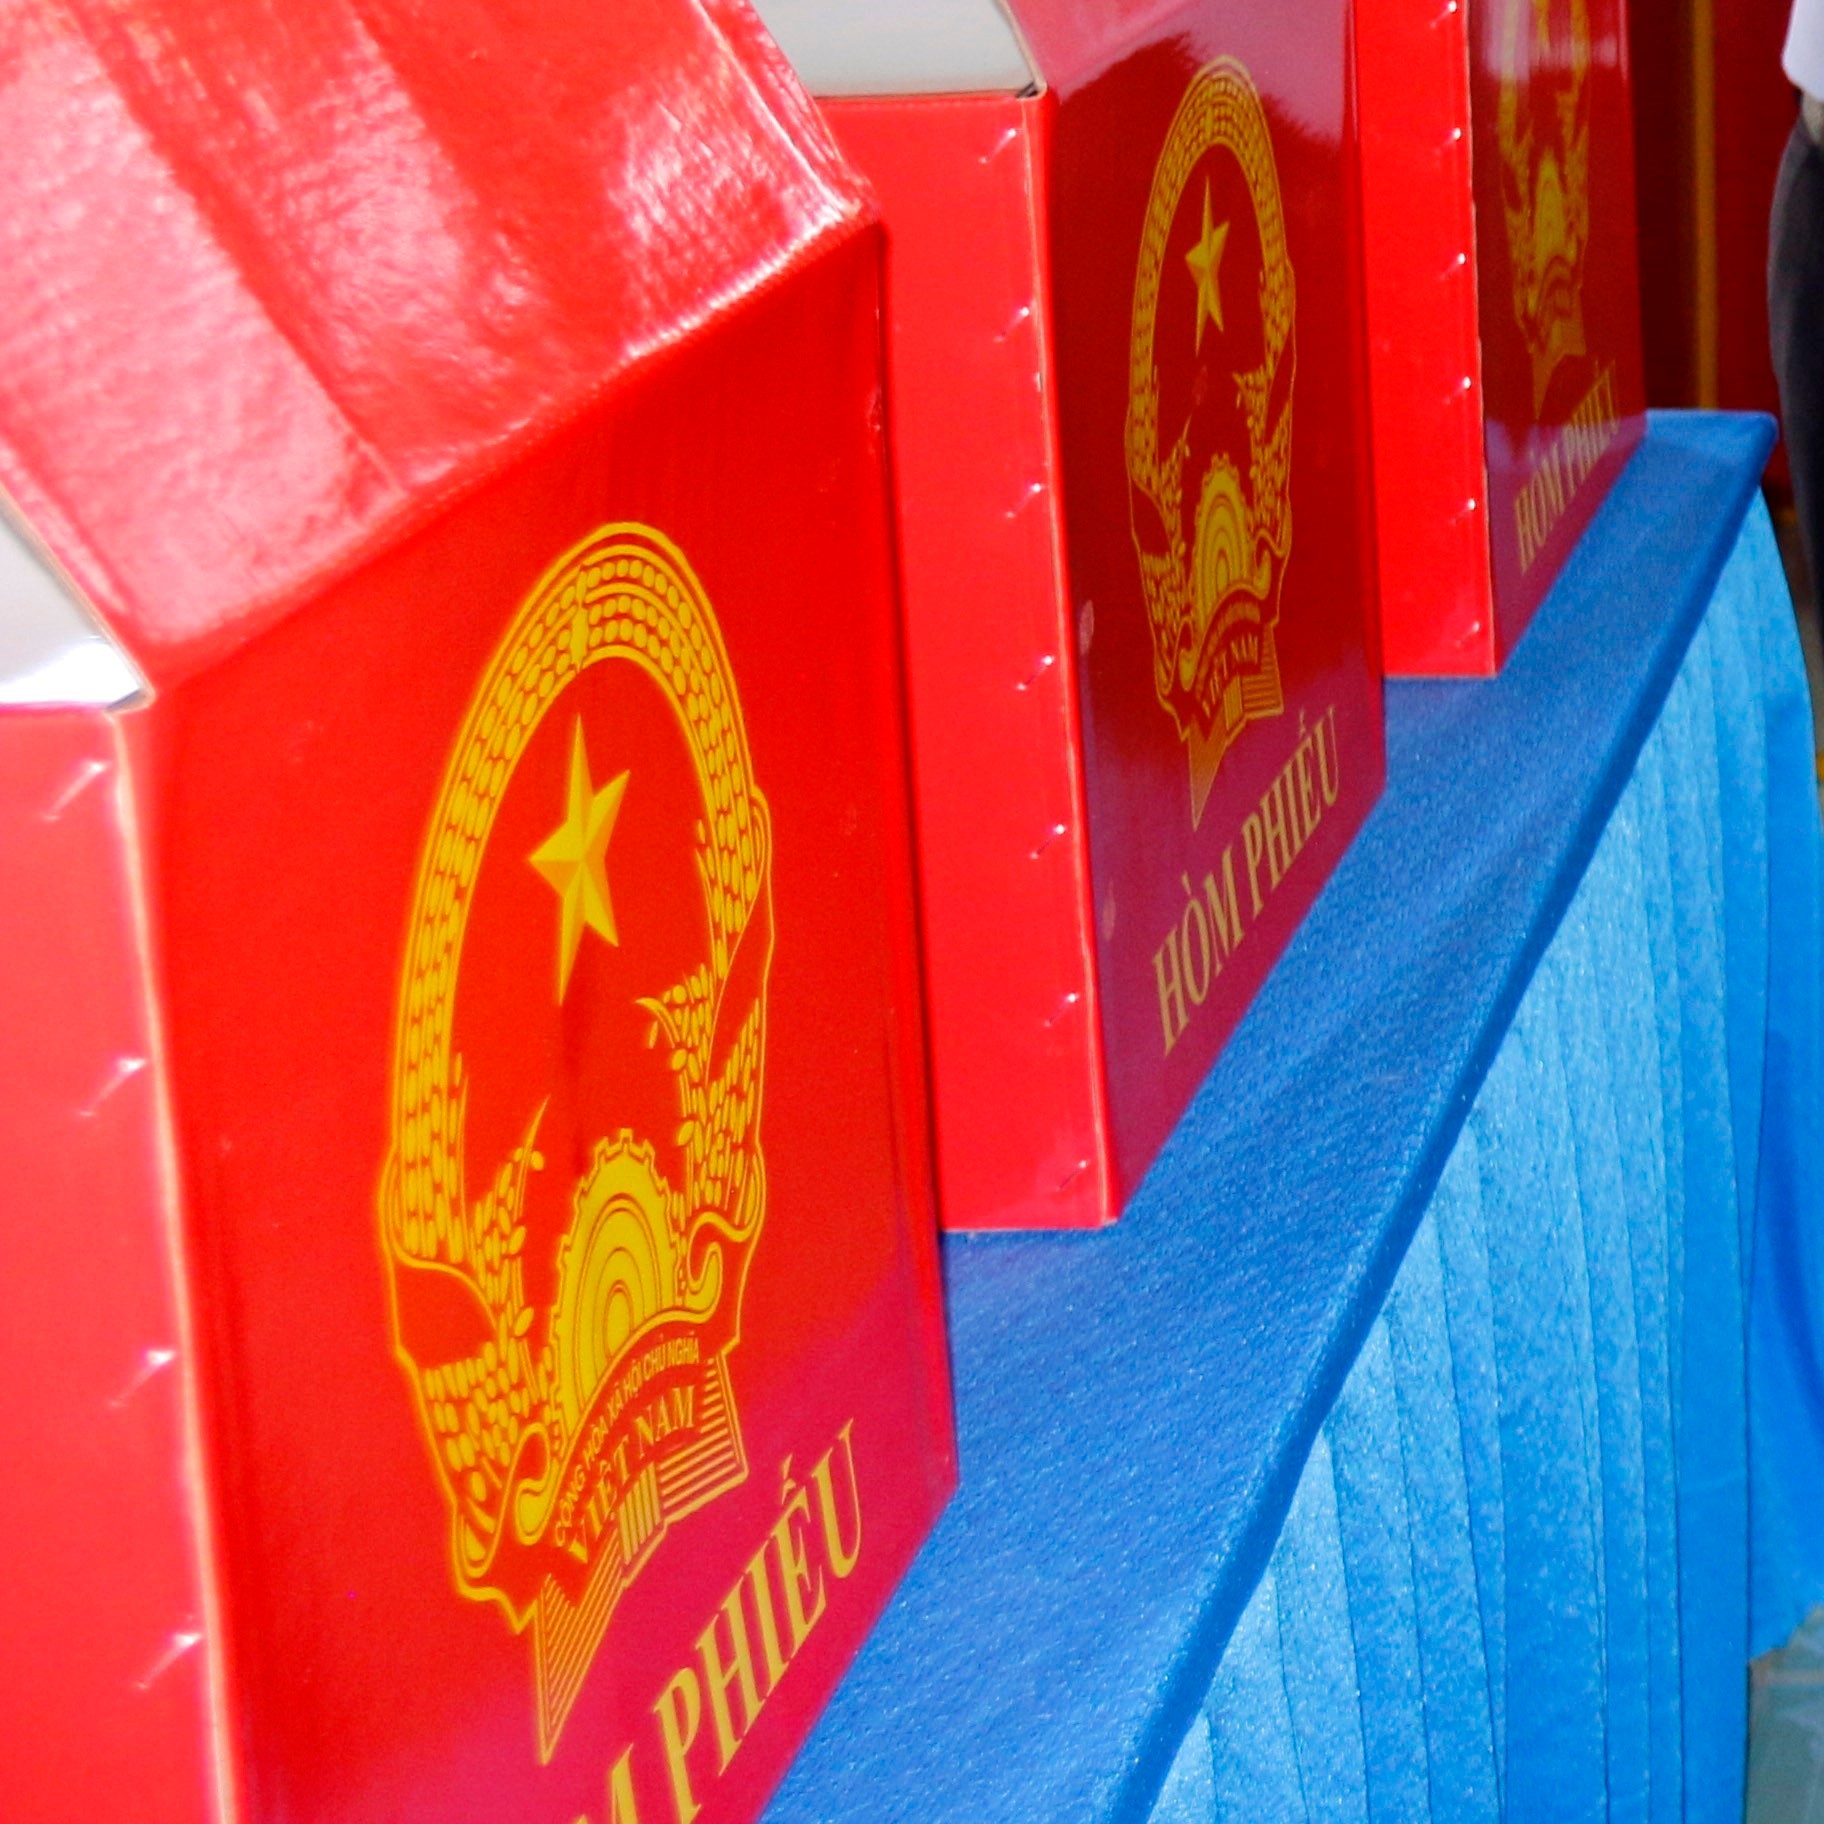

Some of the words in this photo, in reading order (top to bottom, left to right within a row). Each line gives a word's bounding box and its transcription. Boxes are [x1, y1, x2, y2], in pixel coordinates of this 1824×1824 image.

[1151, 871, 1246, 1058] HÒM
[1240, 704, 1341, 920] PHIẾU
[568, 1433, 630, 1564] VIỆT
[634, 1384, 696, 1461] NAM
[652, 1417, 862, 1824] PHIẾU
